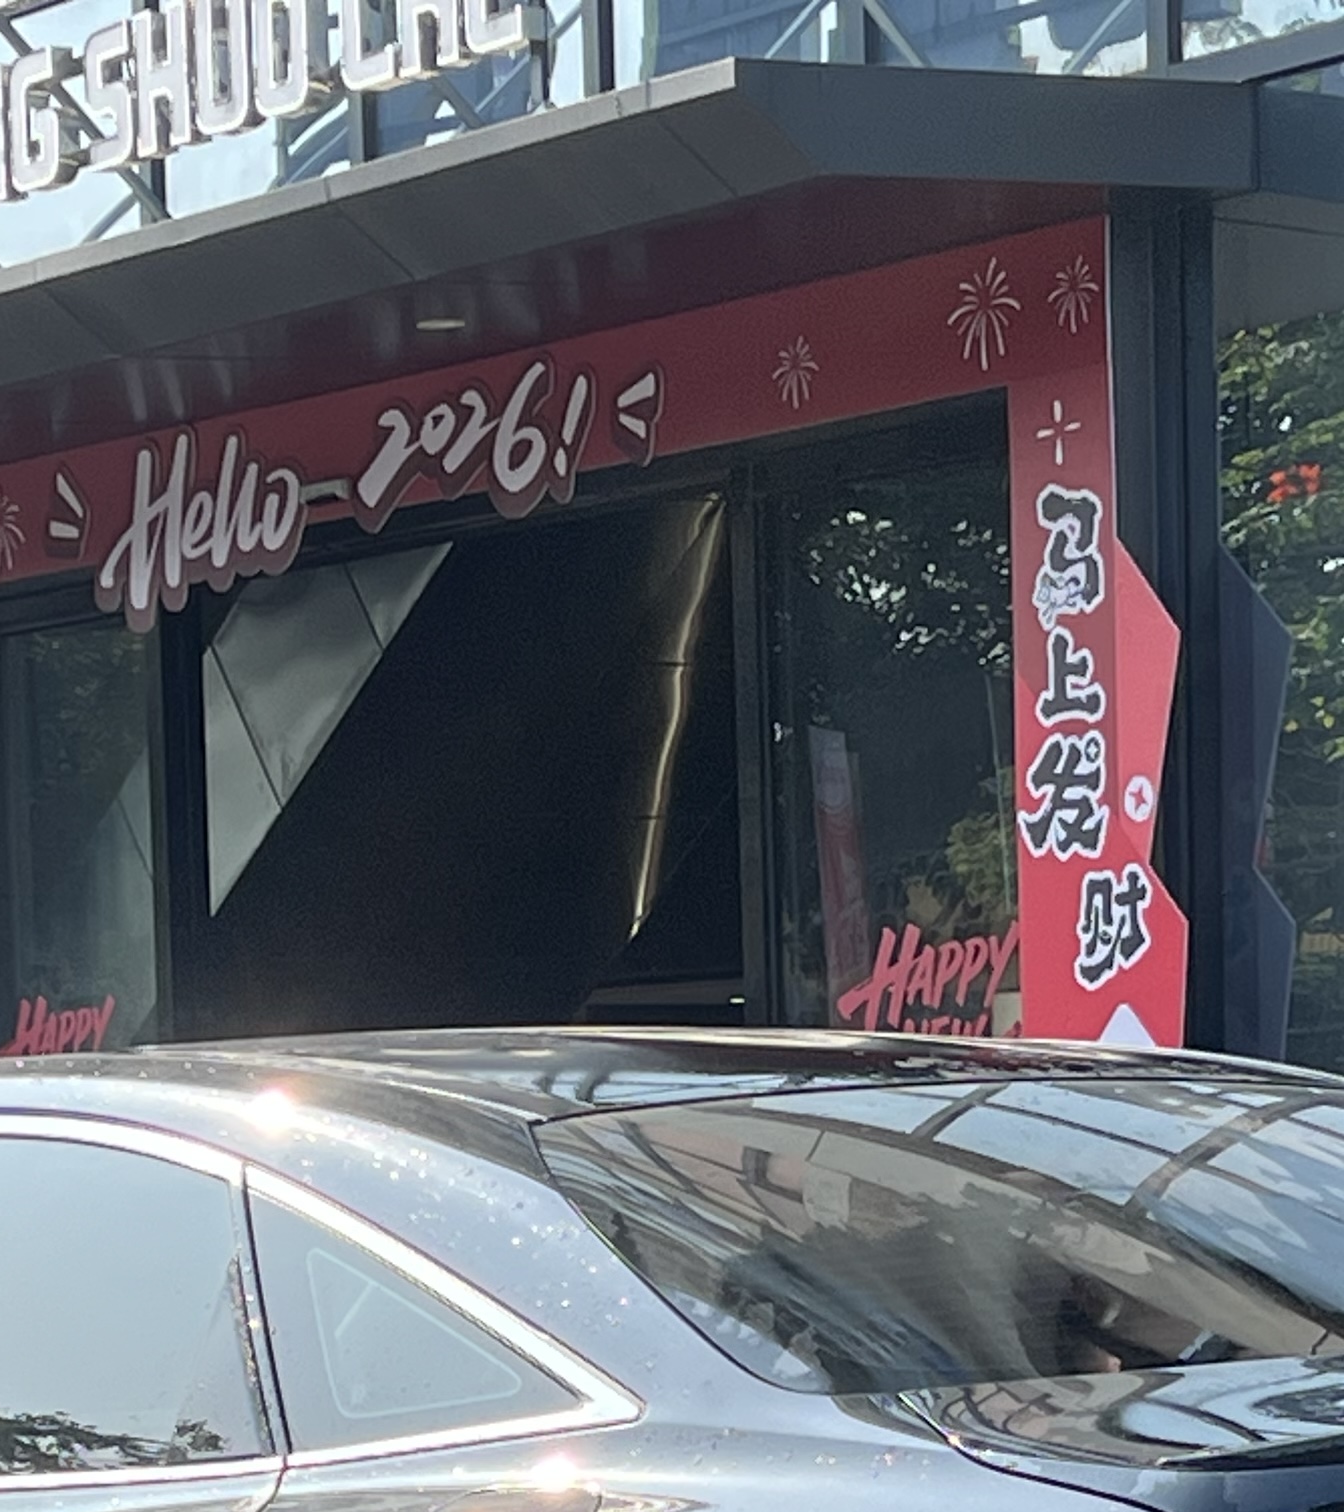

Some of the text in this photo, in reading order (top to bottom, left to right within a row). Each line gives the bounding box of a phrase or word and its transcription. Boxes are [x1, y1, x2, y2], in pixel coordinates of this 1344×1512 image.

[85, 0, 310, 170] SHUO
[100, 361, 587, 610] Hello 2026!
[1019, 485, 1150, 990] 马上发财
[837, 920, 1020, 1032] HAPPY
